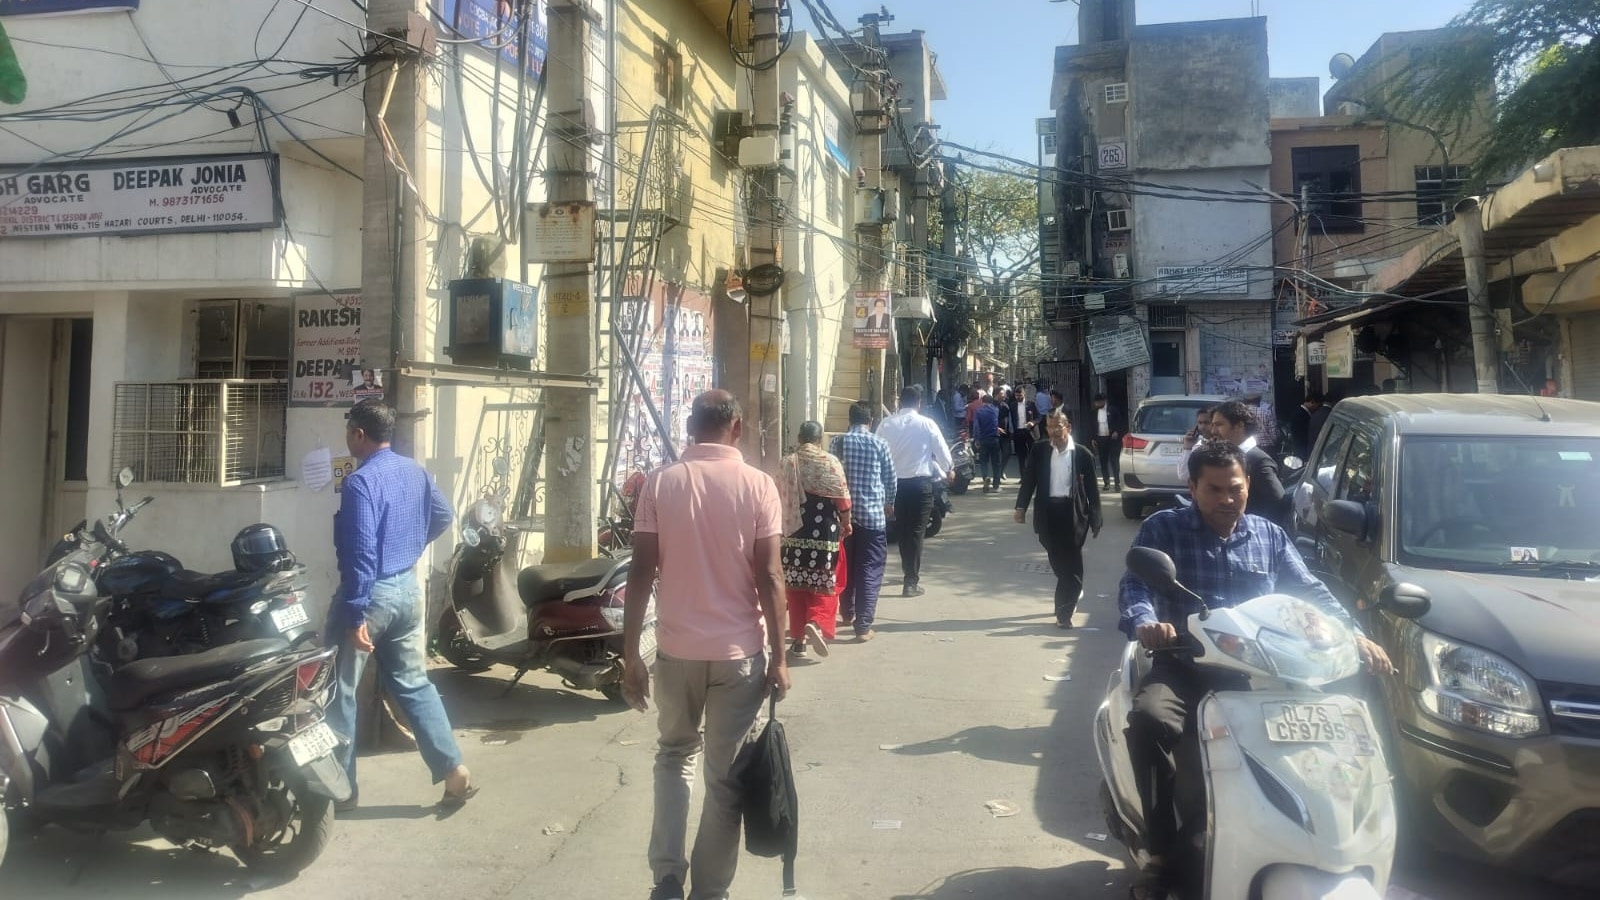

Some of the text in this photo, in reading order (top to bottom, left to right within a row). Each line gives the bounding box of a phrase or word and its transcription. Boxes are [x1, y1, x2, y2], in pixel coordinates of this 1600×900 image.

[1104, 149, 1119, 162] 265
[27, 174, 90, 194] GARG
[113, 164, 247, 190] DEEPAK JONIA
[191, 184, 242, 194] ADVOCATE
[24, 195, 84, 204] ADVOCATE
[162, 194, 225, 206] 9873171656
[88, 221, 100, 229] TIS
[105, 218, 132, 227] HAZARI
[299, 308, 360, 328] RAKESH
[309, 381, 333, 399] 132
[1276, 722, 1346, 741] CF9795
